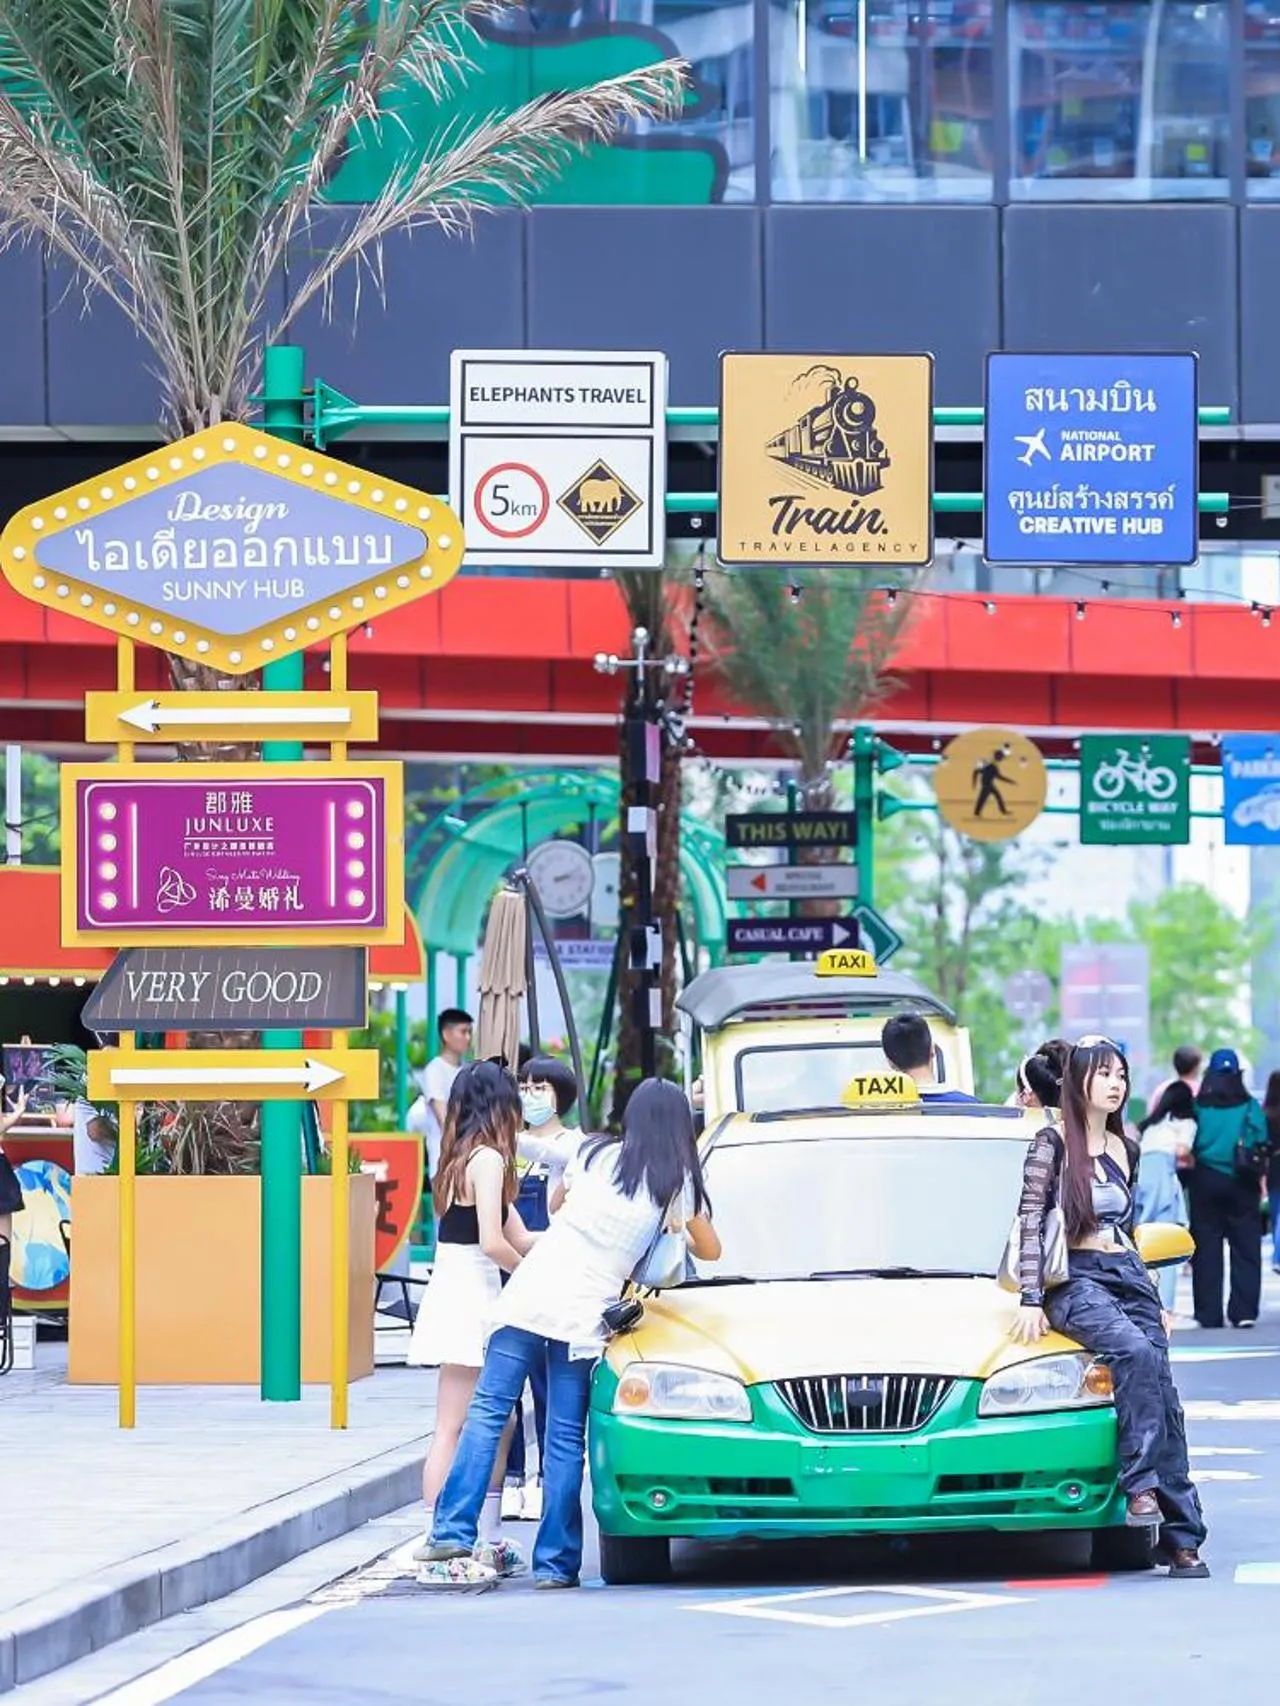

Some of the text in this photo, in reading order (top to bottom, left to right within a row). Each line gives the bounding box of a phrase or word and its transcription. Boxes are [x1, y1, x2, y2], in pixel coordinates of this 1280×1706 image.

[469, 386, 646, 405] ELEPHANTS TRAVEL
[1024, 379, 1157, 413] สนามบิน
[1061, 431, 1121, 441] NATIONAL
[1060, 444, 1156, 462] AIRPORT
[167, 490, 290, 534] Design
[1019, 517, 1164, 535] CREATIVE HUB
[75, 528, 394, 572] ไอเดียออกแบบ
[161, 578, 305, 601] SUNNY HUB
[185, 817, 275, 836] JUNLUXE
[737, 821, 848, 841] THIS WAY!
[734, 926, 824, 942] CASUAL CAFE
[828, 955, 866, 969] TAXI
[124, 970, 323, 1003] VERY GOOD
[855, 1076, 904, 1096] TAXI
